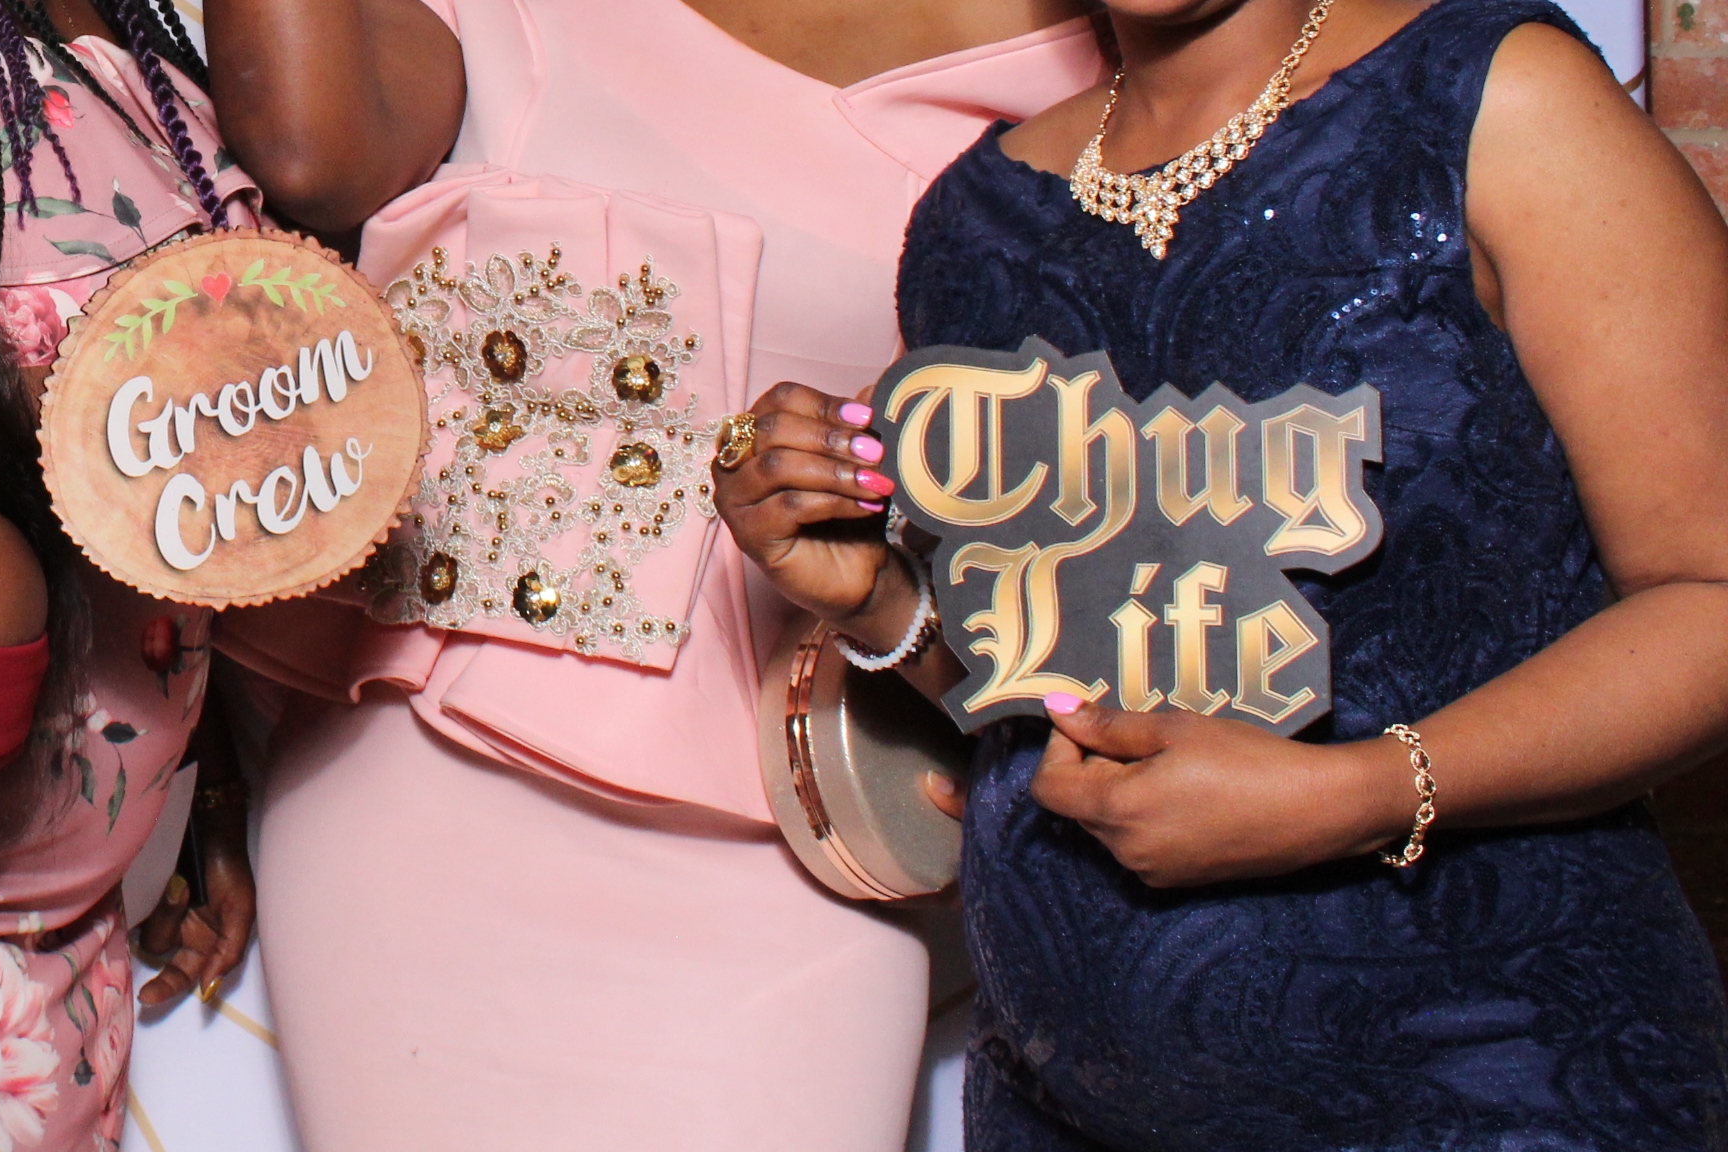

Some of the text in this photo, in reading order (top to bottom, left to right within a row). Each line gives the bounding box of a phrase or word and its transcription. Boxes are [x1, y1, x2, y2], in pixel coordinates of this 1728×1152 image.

[107, 330, 373, 478] Groom
[884, 357, 1368, 556] Thug
[155, 437, 373, 571] Crew
[949, 541, 1319, 724] Life
